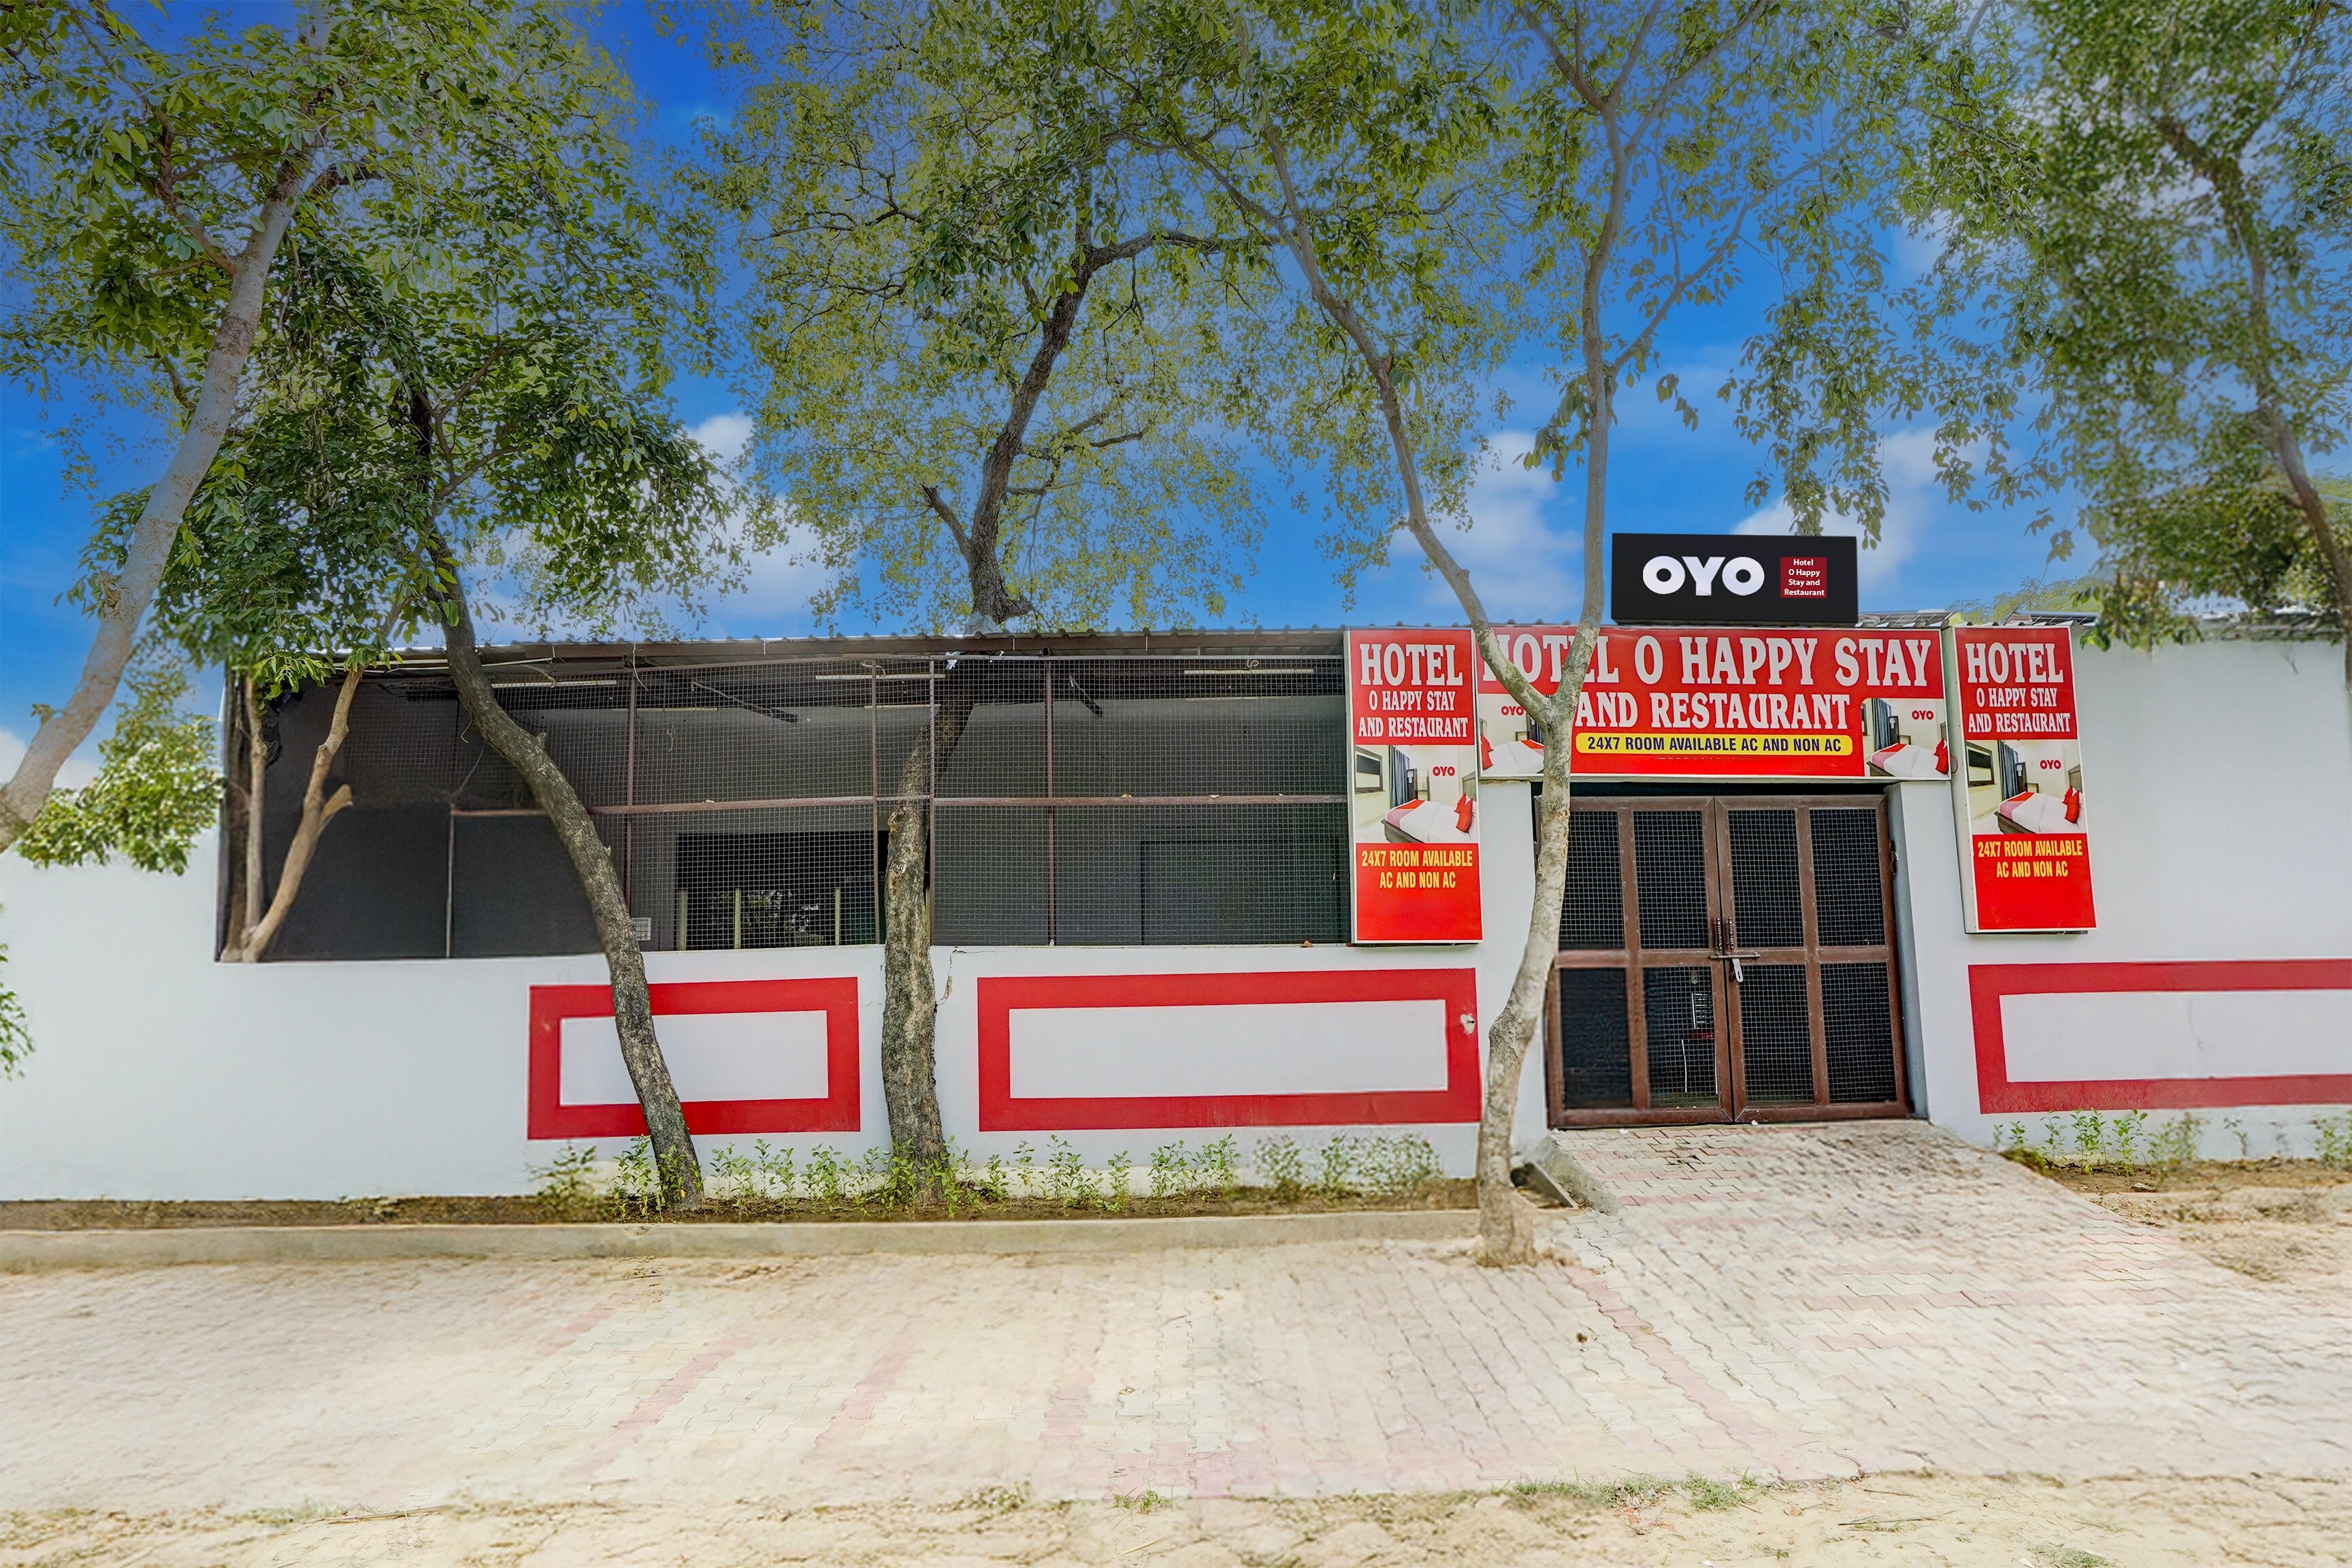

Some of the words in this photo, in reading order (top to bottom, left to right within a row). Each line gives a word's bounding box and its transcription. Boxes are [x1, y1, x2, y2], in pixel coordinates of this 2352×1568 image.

[1643, 555, 1765, 596] OYO
[1796, 569, 1820, 577] Happy
[1788, 578, 1804, 587] Stay
[1360, 643, 1463, 686] HOTEL
[1483, 634, 1619, 684] OTL
[1635, 635, 1663, 685] O
[1679, 636, 1818, 685] HAPPY
[1835, 638, 1931, 687] STAY
[1965, 642, 2064, 684] HOTEL
[1369, 690, 1377, 710] O
[1382, 690, 1422, 711] HAPPY
[1426, 690, 1456, 711] STAY
[1976, 687, 1985, 707] O
[1988, 687, 2026, 707] HAPPY
[2030, 687, 2057, 707] STAY
[1501, 706, 1524, 716] OYO
[1575, 691, 1638, 728] AND
[1650, 692, 1850, 730] RESTAURANT
[1912, 710, 1934, 720] OYO
[1358, 717, 1384, 737] AND
[1388, 717, 1469, 738] RESTAURANT
[1968, 713, 1992, 733] AND
[1995, 713, 2070, 733] RESTAURANT
[1588, 736, 1620, 750] 24X7
[1625, 737, 1665, 751] ROOM
[1669, 737, 1736, 751] AVAILABLE
[1741, 738, 1759, 752] AC
[1763, 738, 1789, 752] AND
[1793, 738, 1820, 752] NON
[1824, 738, 1842, 752] AC
[1433, 766, 1456, 777] OYO
[2040, 760, 2061, 770] OYO
[1978, 841, 2001, 858] 24X7
[2004, 840, 2032, 858] ROOM
[2035, 840, 2082, 857] AVAILABLE
[1362, 851, 1386, 867] 24X7
[1390, 850, 1419, 867] ROOM
[1422, 850, 1473, 867] AVAILABLE
[1996, 862, 2009, 878] AC
[2012, 861, 2031, 877] AND
[2033, 861, 2053, 877] NON
[2055, 861, 2068, 877] AC
[1379, 872, 1393, 888] AC
[1396, 872, 1416, 888] AND
[1419, 872, 1439, 888] NON
[1442, 871, 1456, 888] AC
